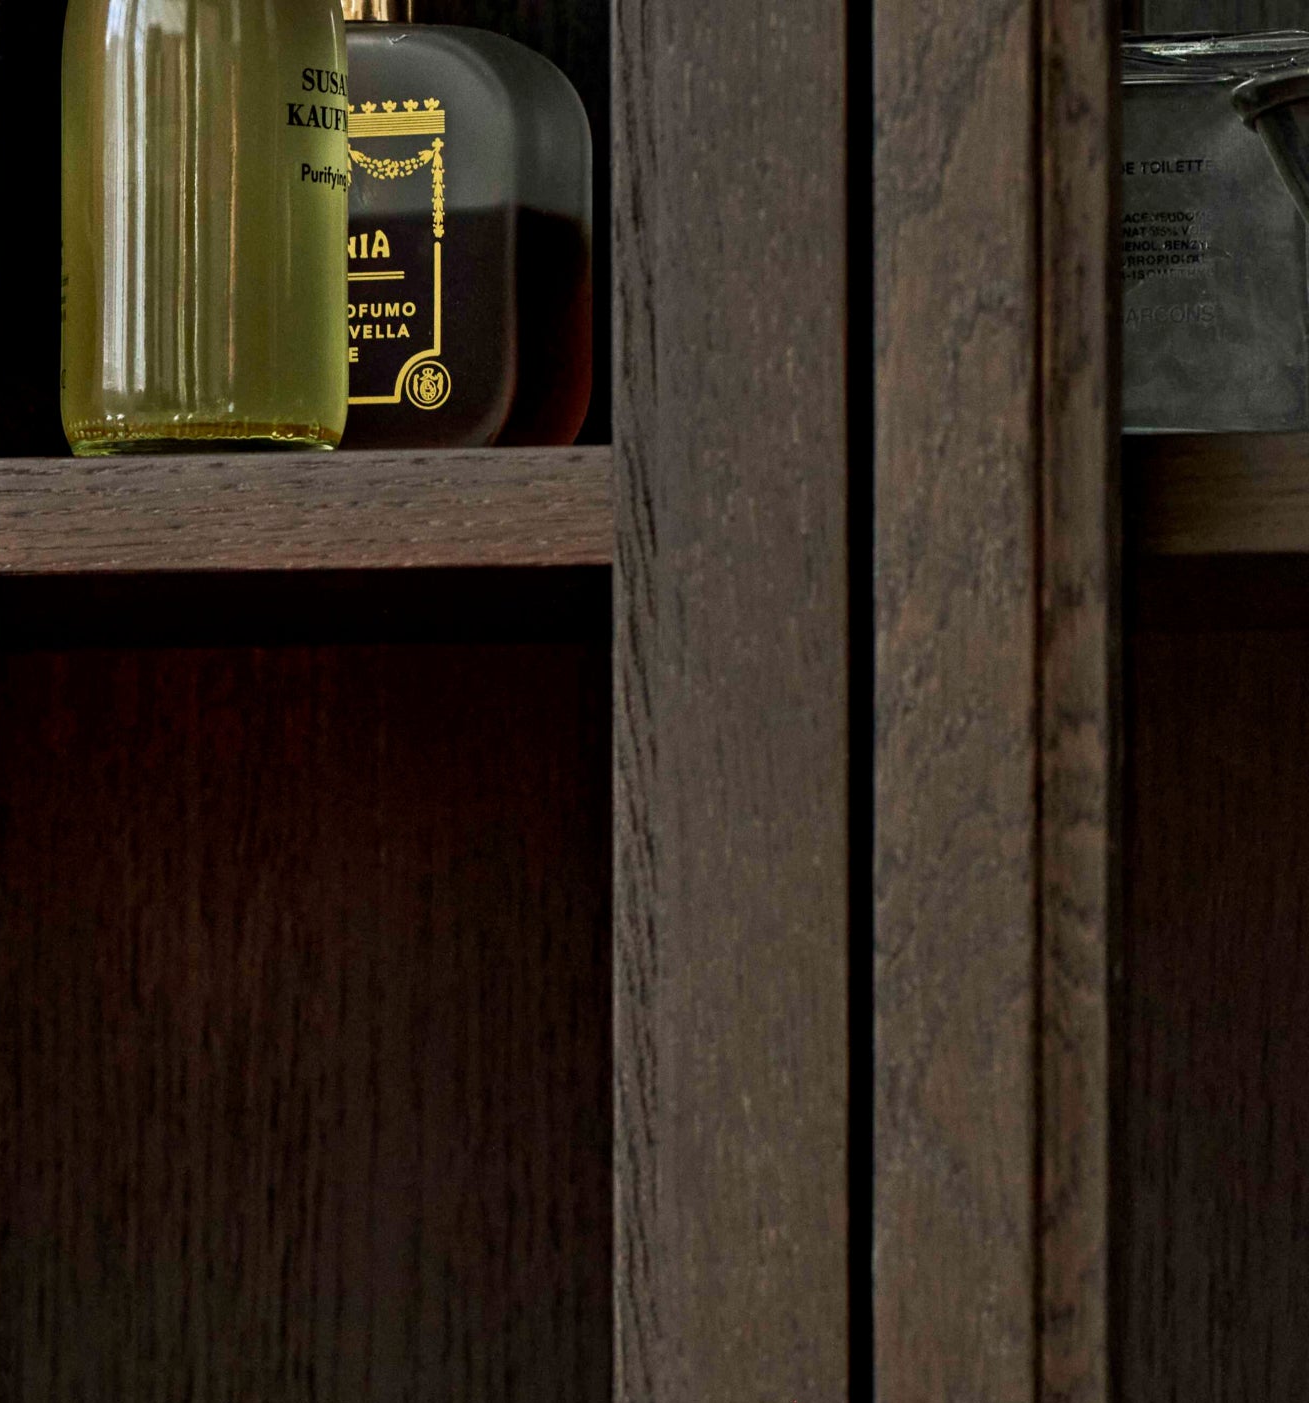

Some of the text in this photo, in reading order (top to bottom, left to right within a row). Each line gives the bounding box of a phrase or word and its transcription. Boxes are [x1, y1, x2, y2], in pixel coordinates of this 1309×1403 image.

[301, 163, 347, 192] Purifying
[347, 301, 417, 319] OFUMO
[348, 323, 411, 340] VELLA
